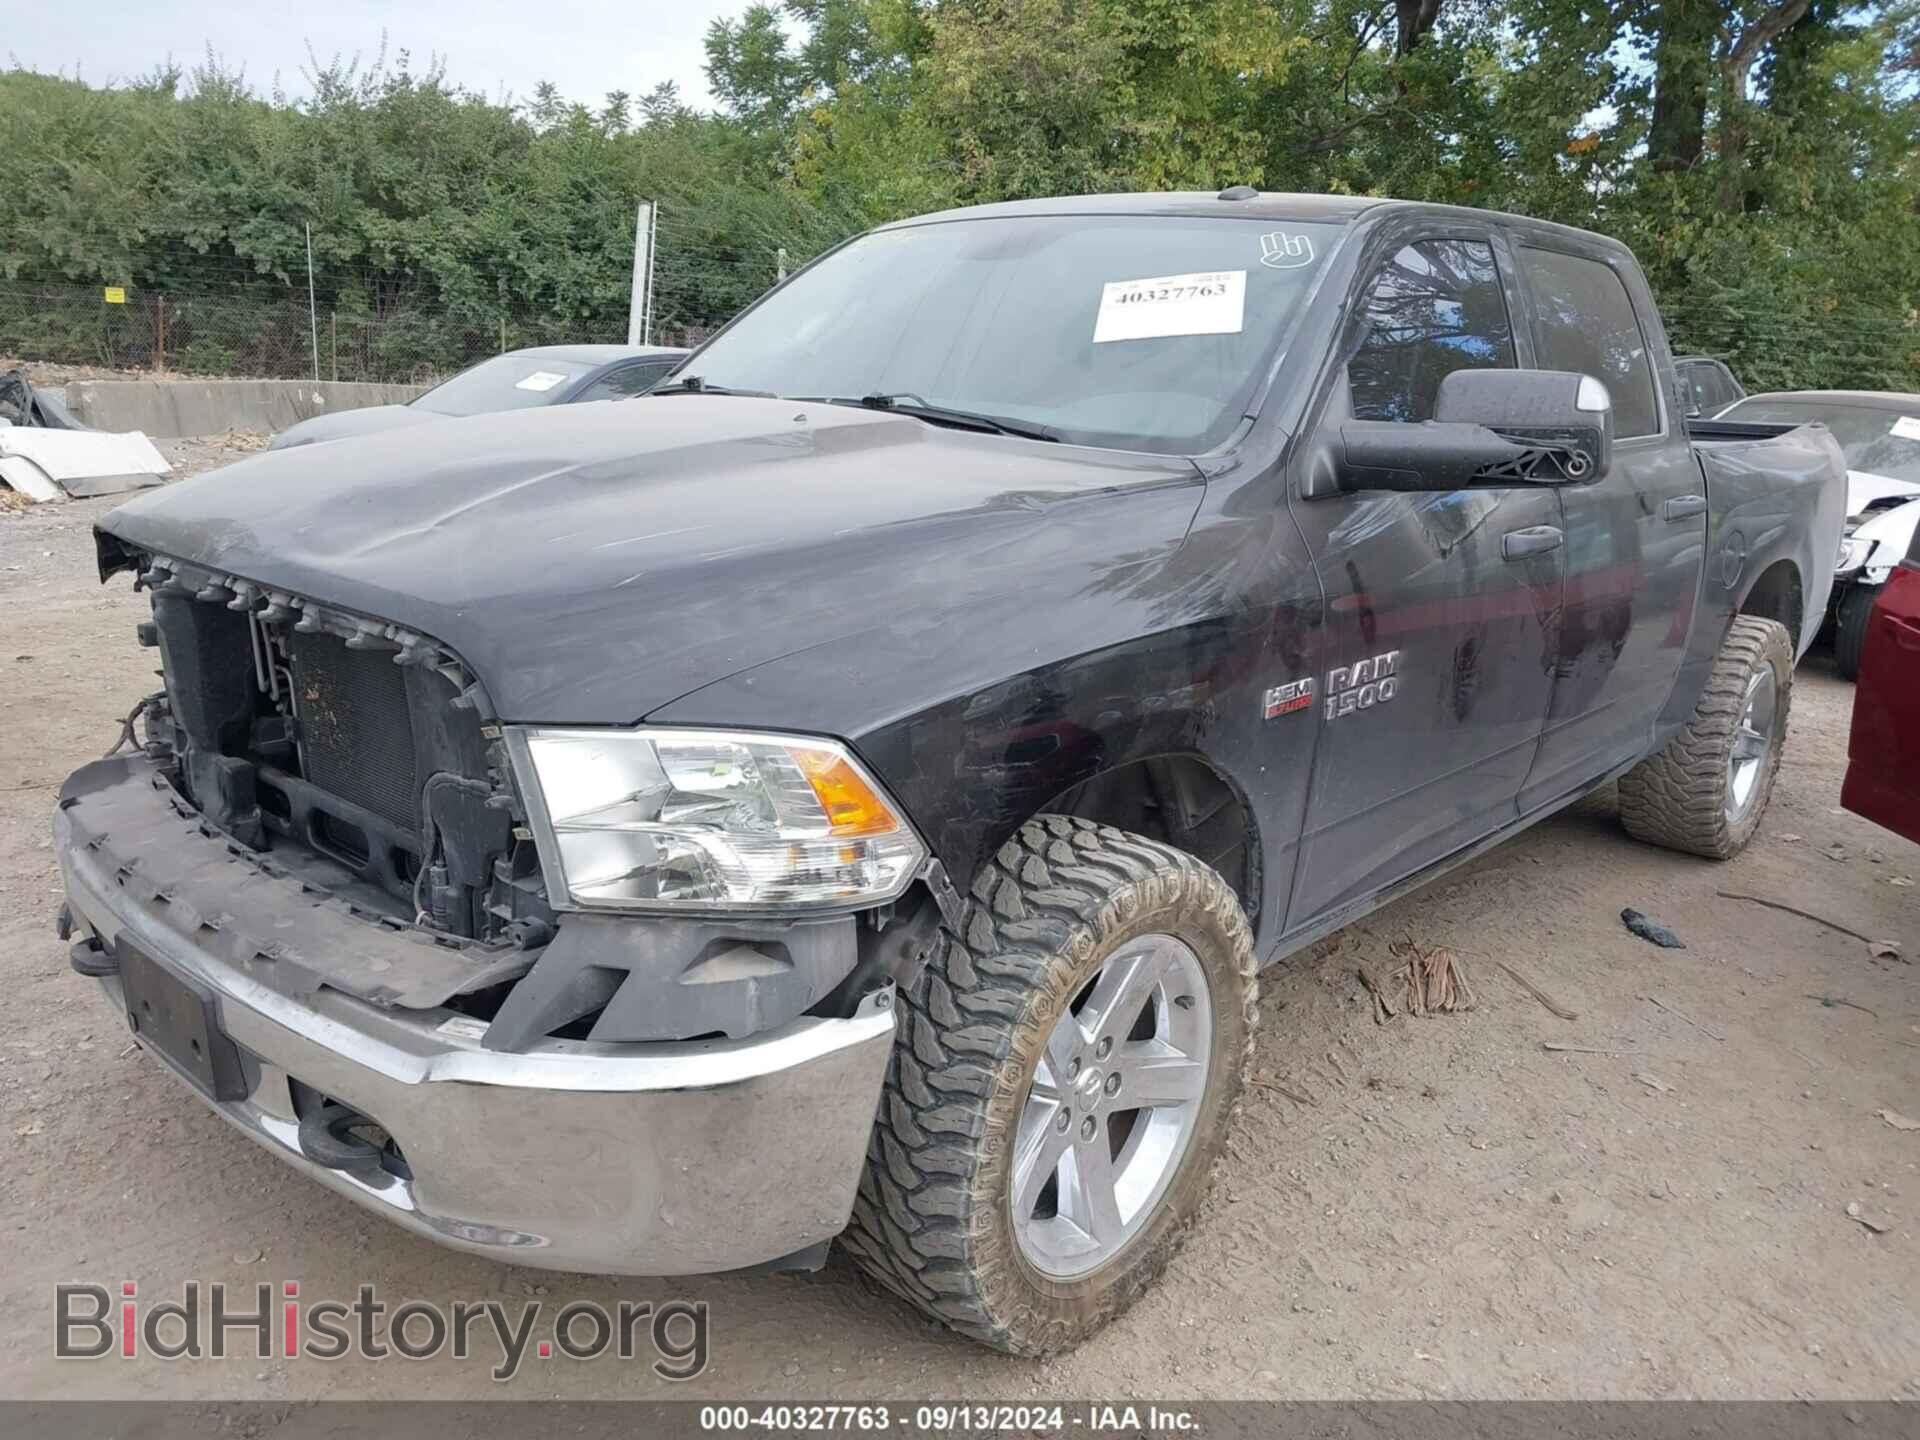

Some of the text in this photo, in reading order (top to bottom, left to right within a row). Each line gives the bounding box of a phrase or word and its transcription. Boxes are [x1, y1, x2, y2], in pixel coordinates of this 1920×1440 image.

[1115, 284, 1226, 304] 40327763
[1328, 650, 1400, 695] RAM
[1326, 677, 1399, 720] 1500
